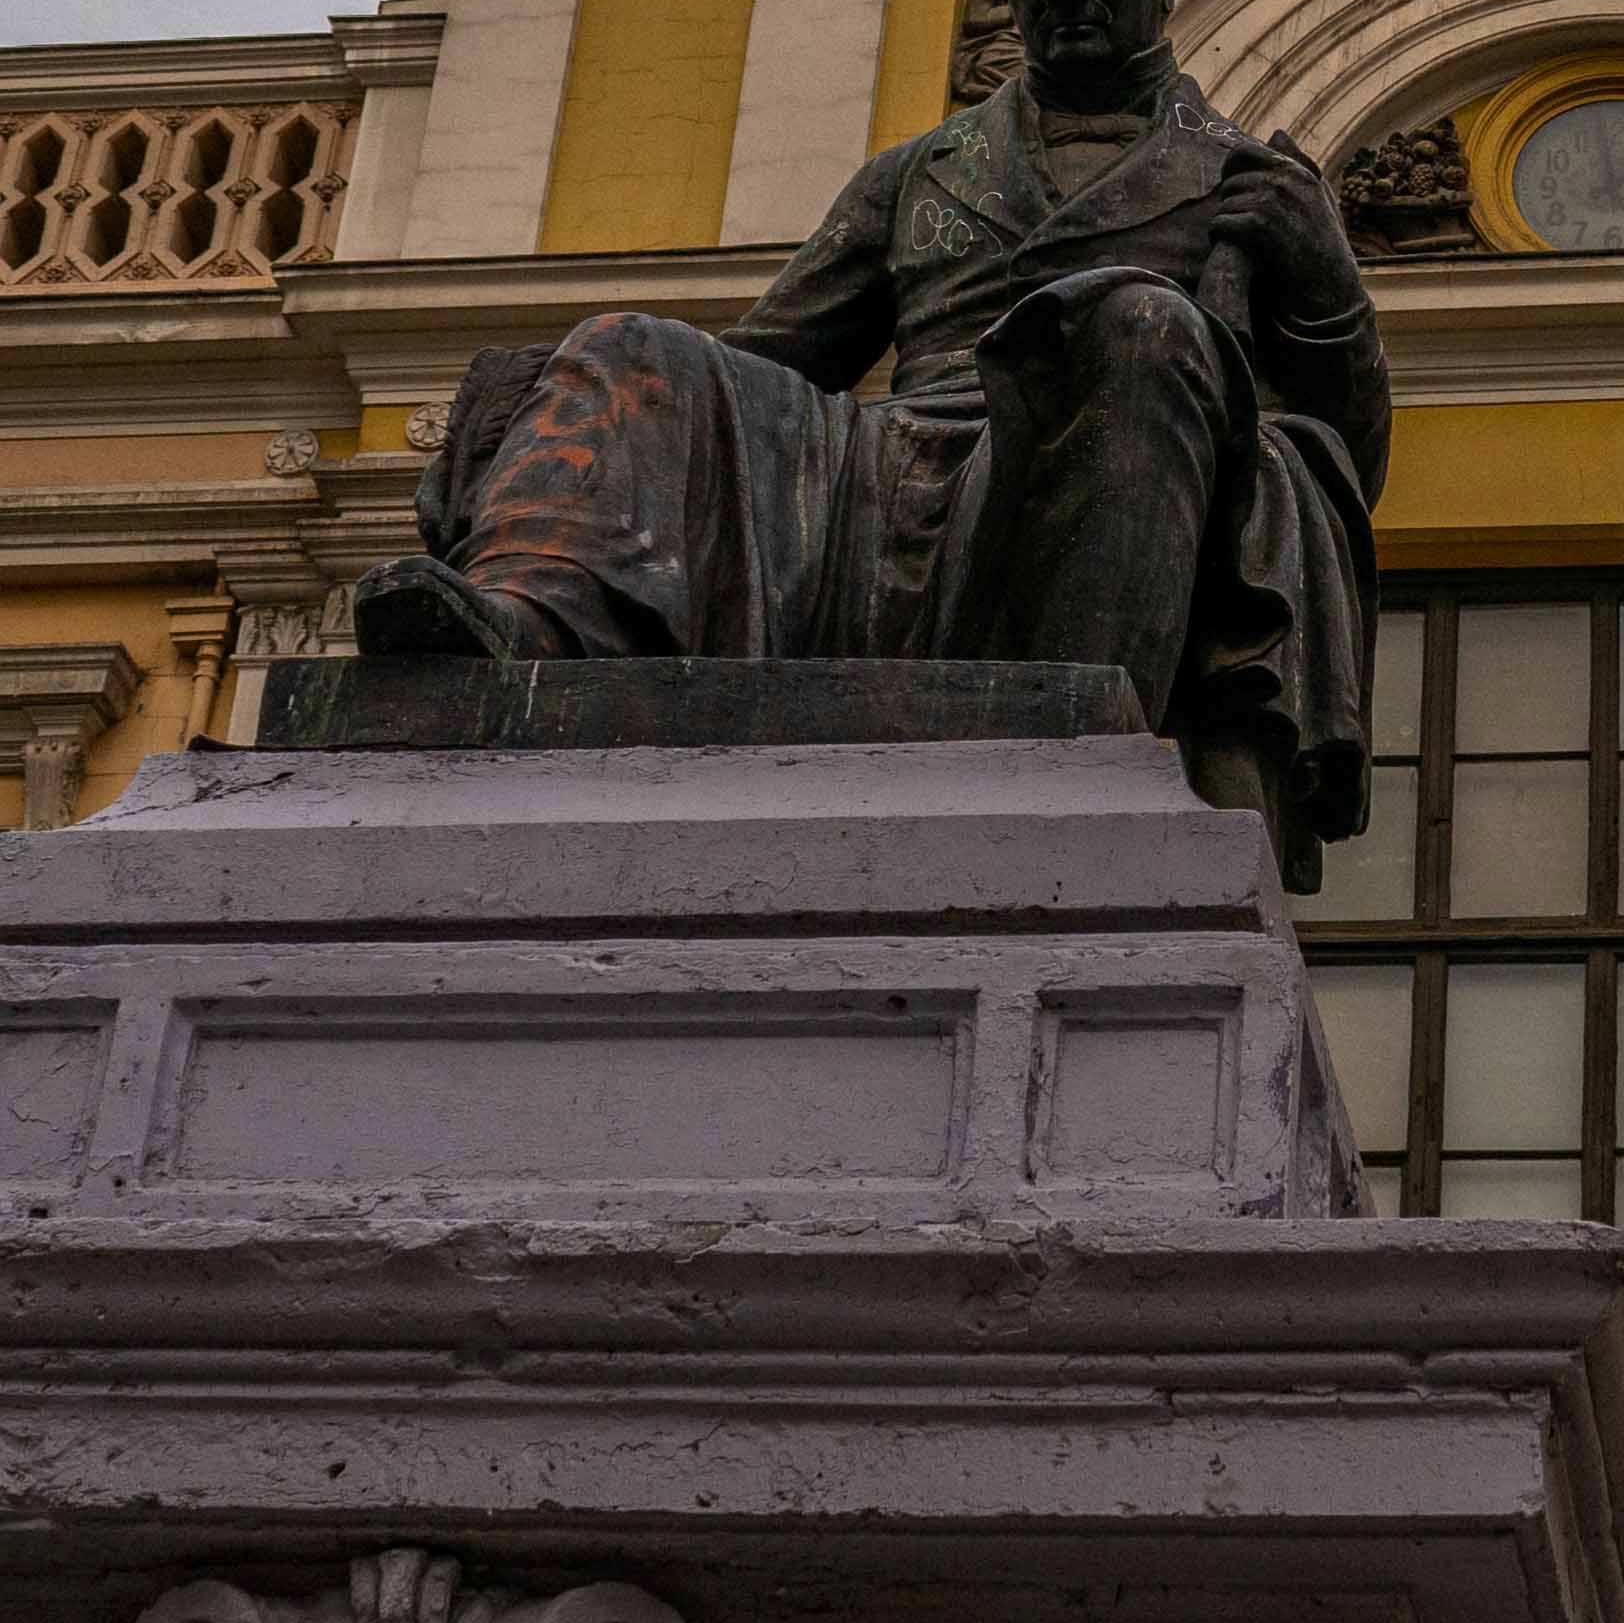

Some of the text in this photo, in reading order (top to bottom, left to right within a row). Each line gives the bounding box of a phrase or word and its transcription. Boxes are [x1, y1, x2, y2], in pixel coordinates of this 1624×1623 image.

[1545, 149, 1570, 173] 10
[1539, 176, 1558, 200] 9
[1546, 201, 1567, 227] 8
[1572, 221, 1589, 246] 7
[1603, 225, 1623, 249] 6
